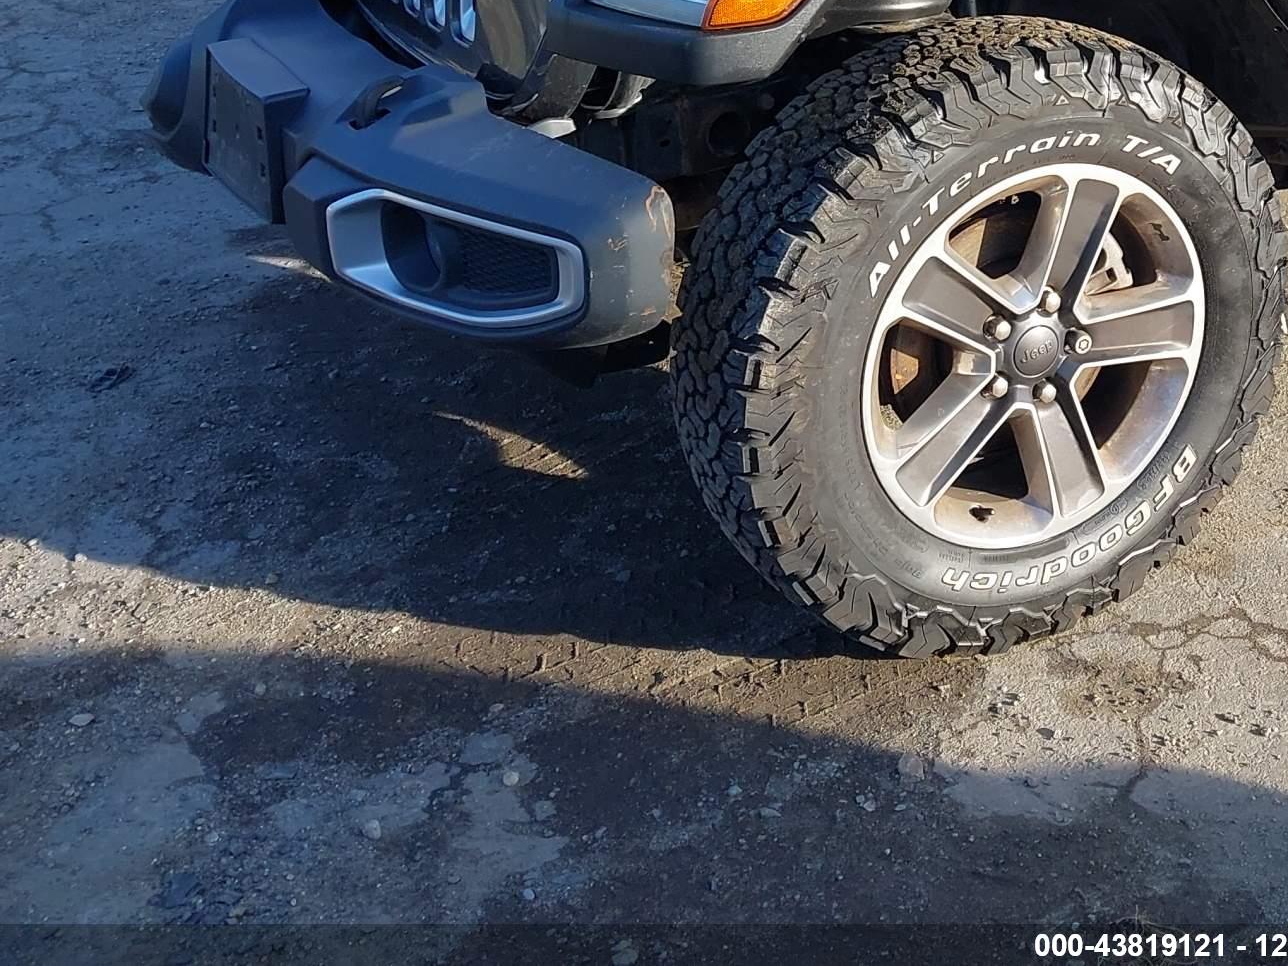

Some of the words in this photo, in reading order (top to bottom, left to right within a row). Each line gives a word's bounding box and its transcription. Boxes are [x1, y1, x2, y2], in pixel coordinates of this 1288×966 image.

[868, 130, 1101, 298] All-Terrain
[1119, 134, 1183, 176] T/A
[1020, 340, 1053, 364] Jeep
[941, 444, 1198, 594] BFGoodrich
